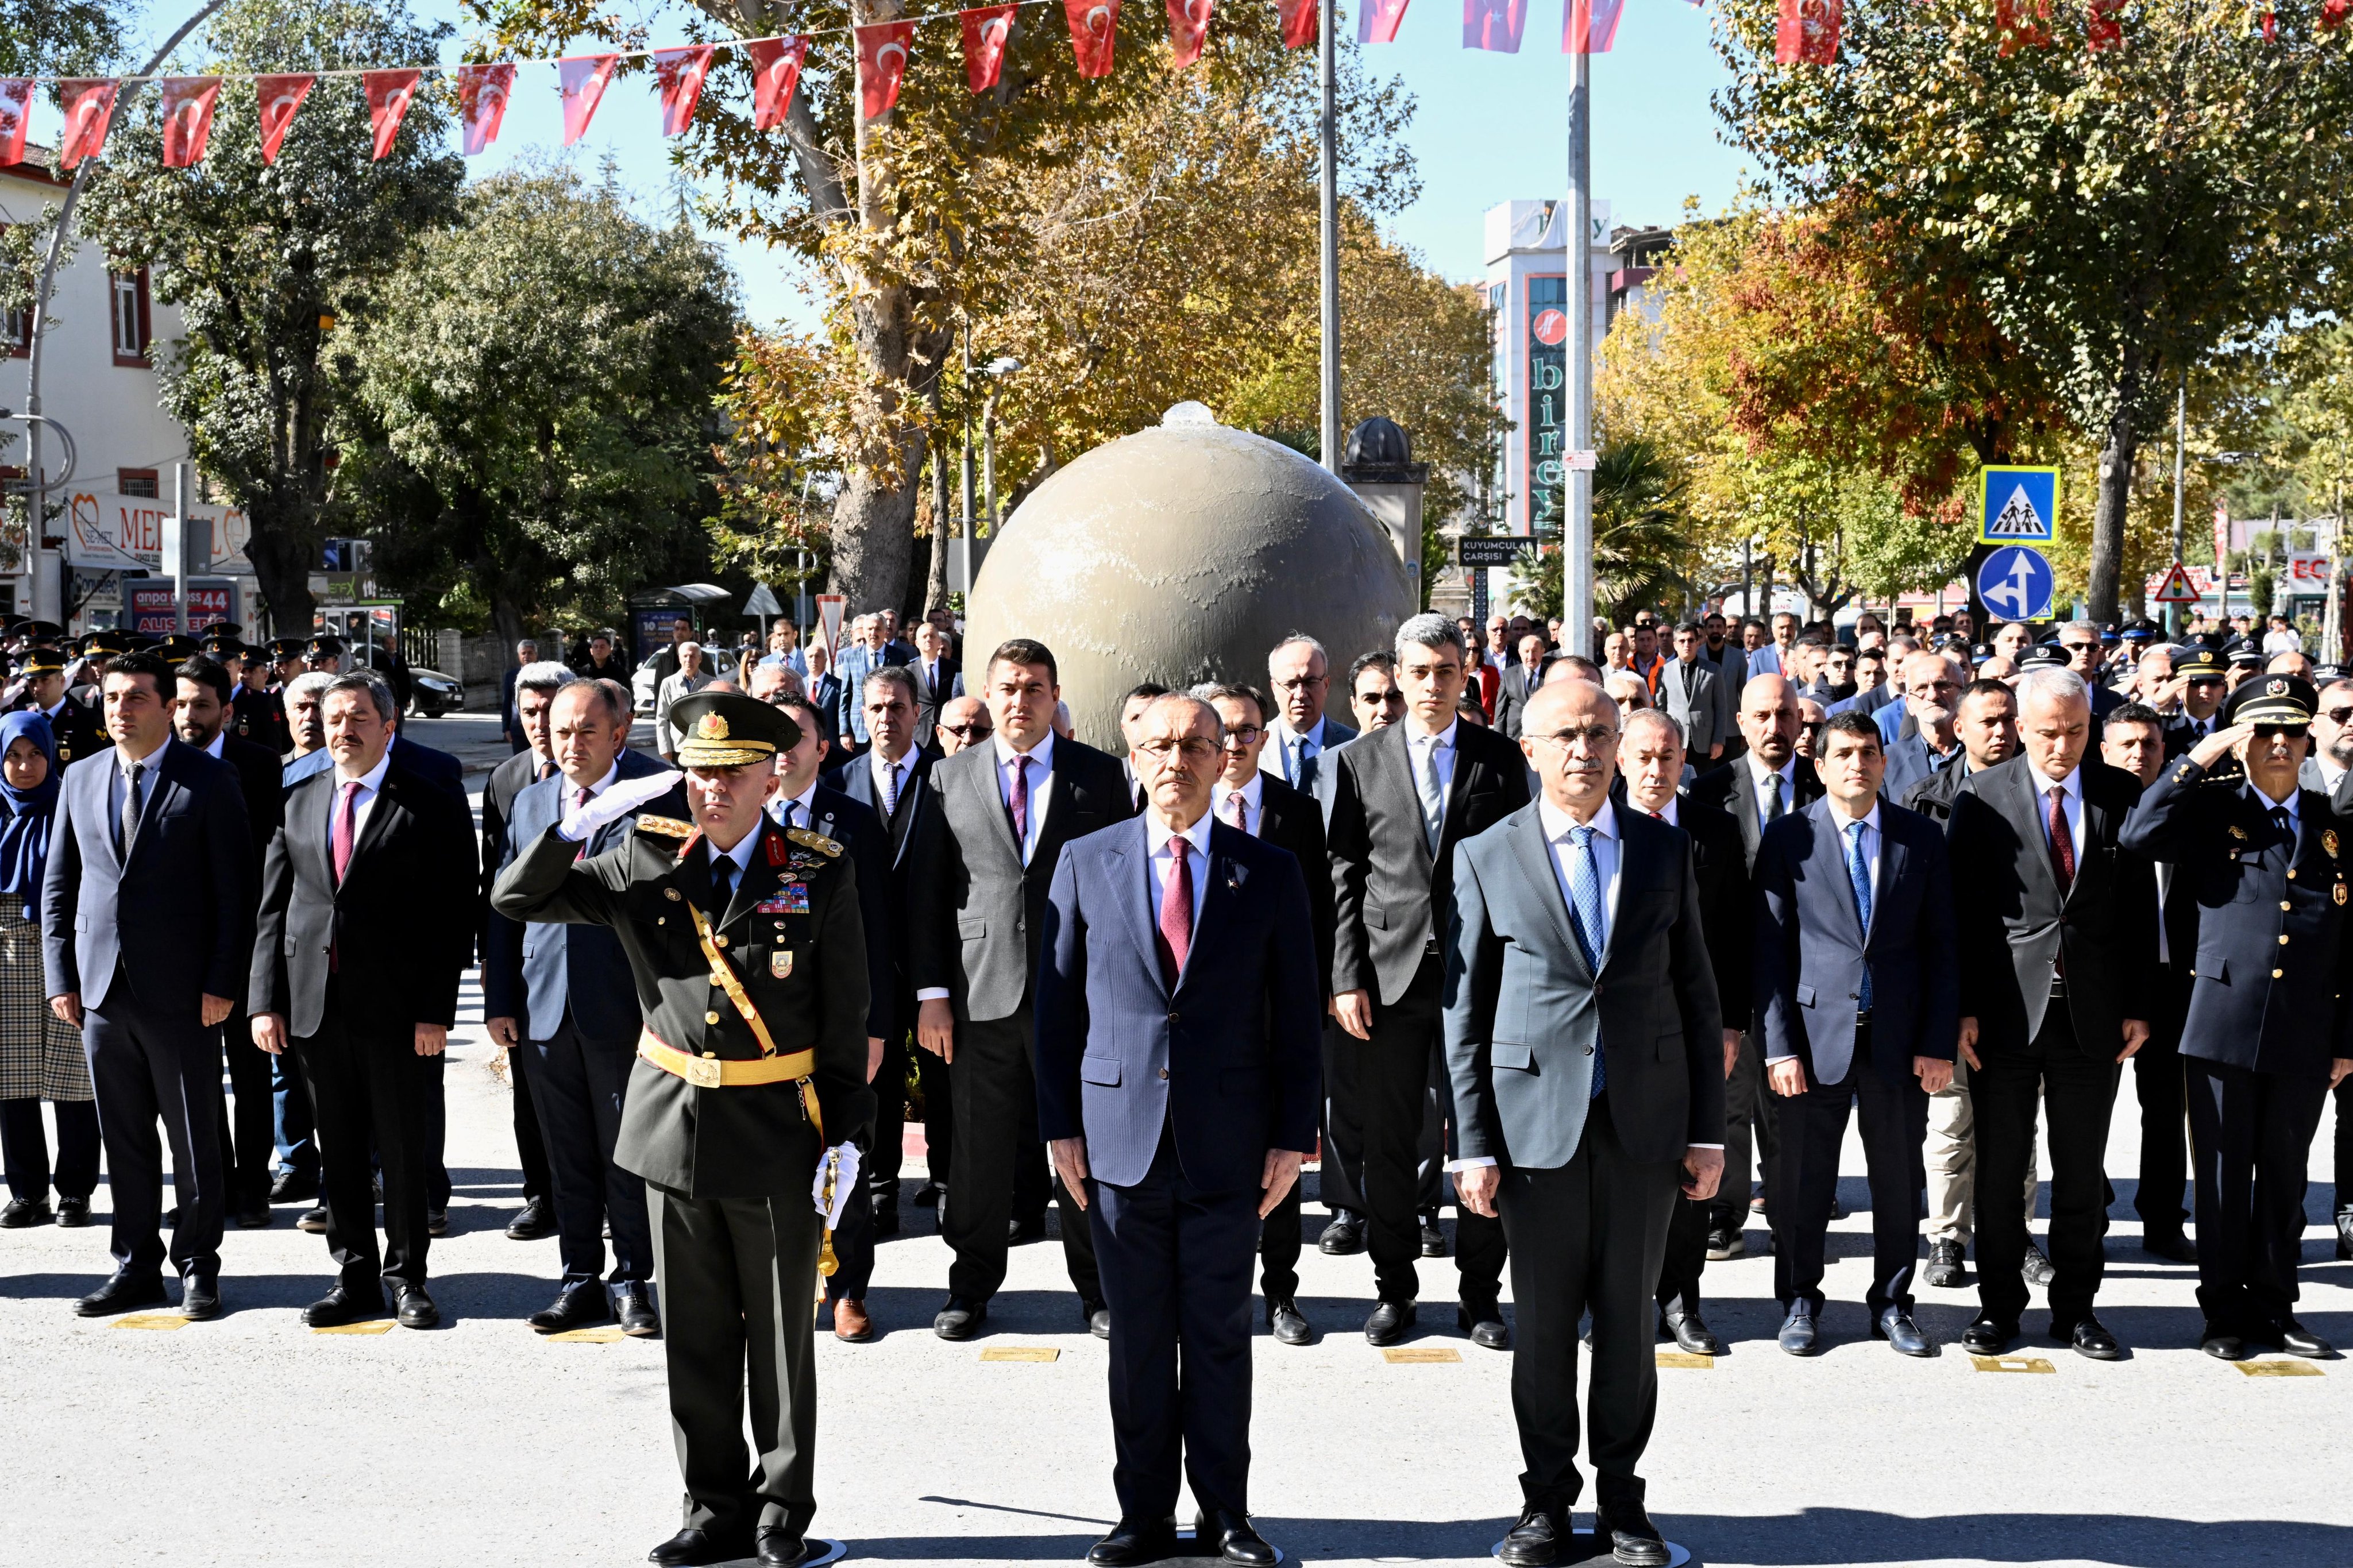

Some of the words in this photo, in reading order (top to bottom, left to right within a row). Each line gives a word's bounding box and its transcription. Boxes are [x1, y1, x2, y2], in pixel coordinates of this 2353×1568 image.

[1464, 542, 1532, 550] KUYUMCULA
[1463, 552, 1502, 562] ÇARŞISI
[137, 592, 167, 606] anpa
[202, 592, 226, 609] 44
